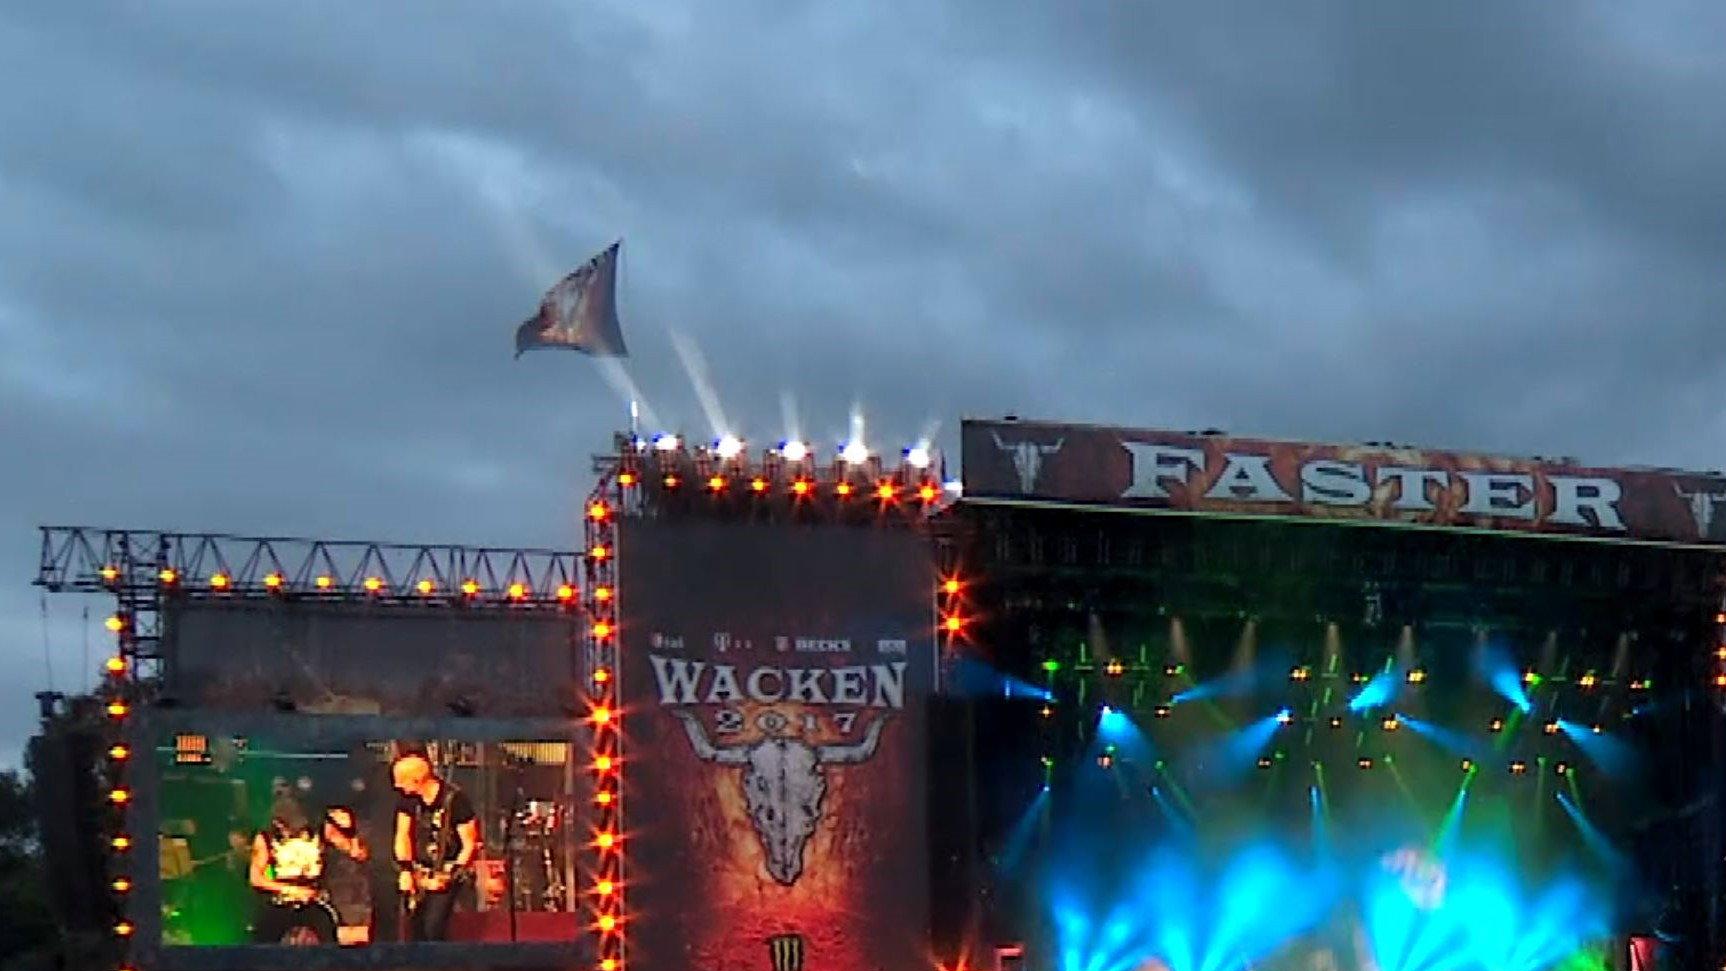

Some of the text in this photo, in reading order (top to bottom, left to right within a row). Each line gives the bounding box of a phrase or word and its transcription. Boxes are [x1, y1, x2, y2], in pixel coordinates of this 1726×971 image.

[1120, 440, 1627, 532] FASTER
[649, 653, 908, 708] WACKEN
[713, 708, 859, 734] 2017
